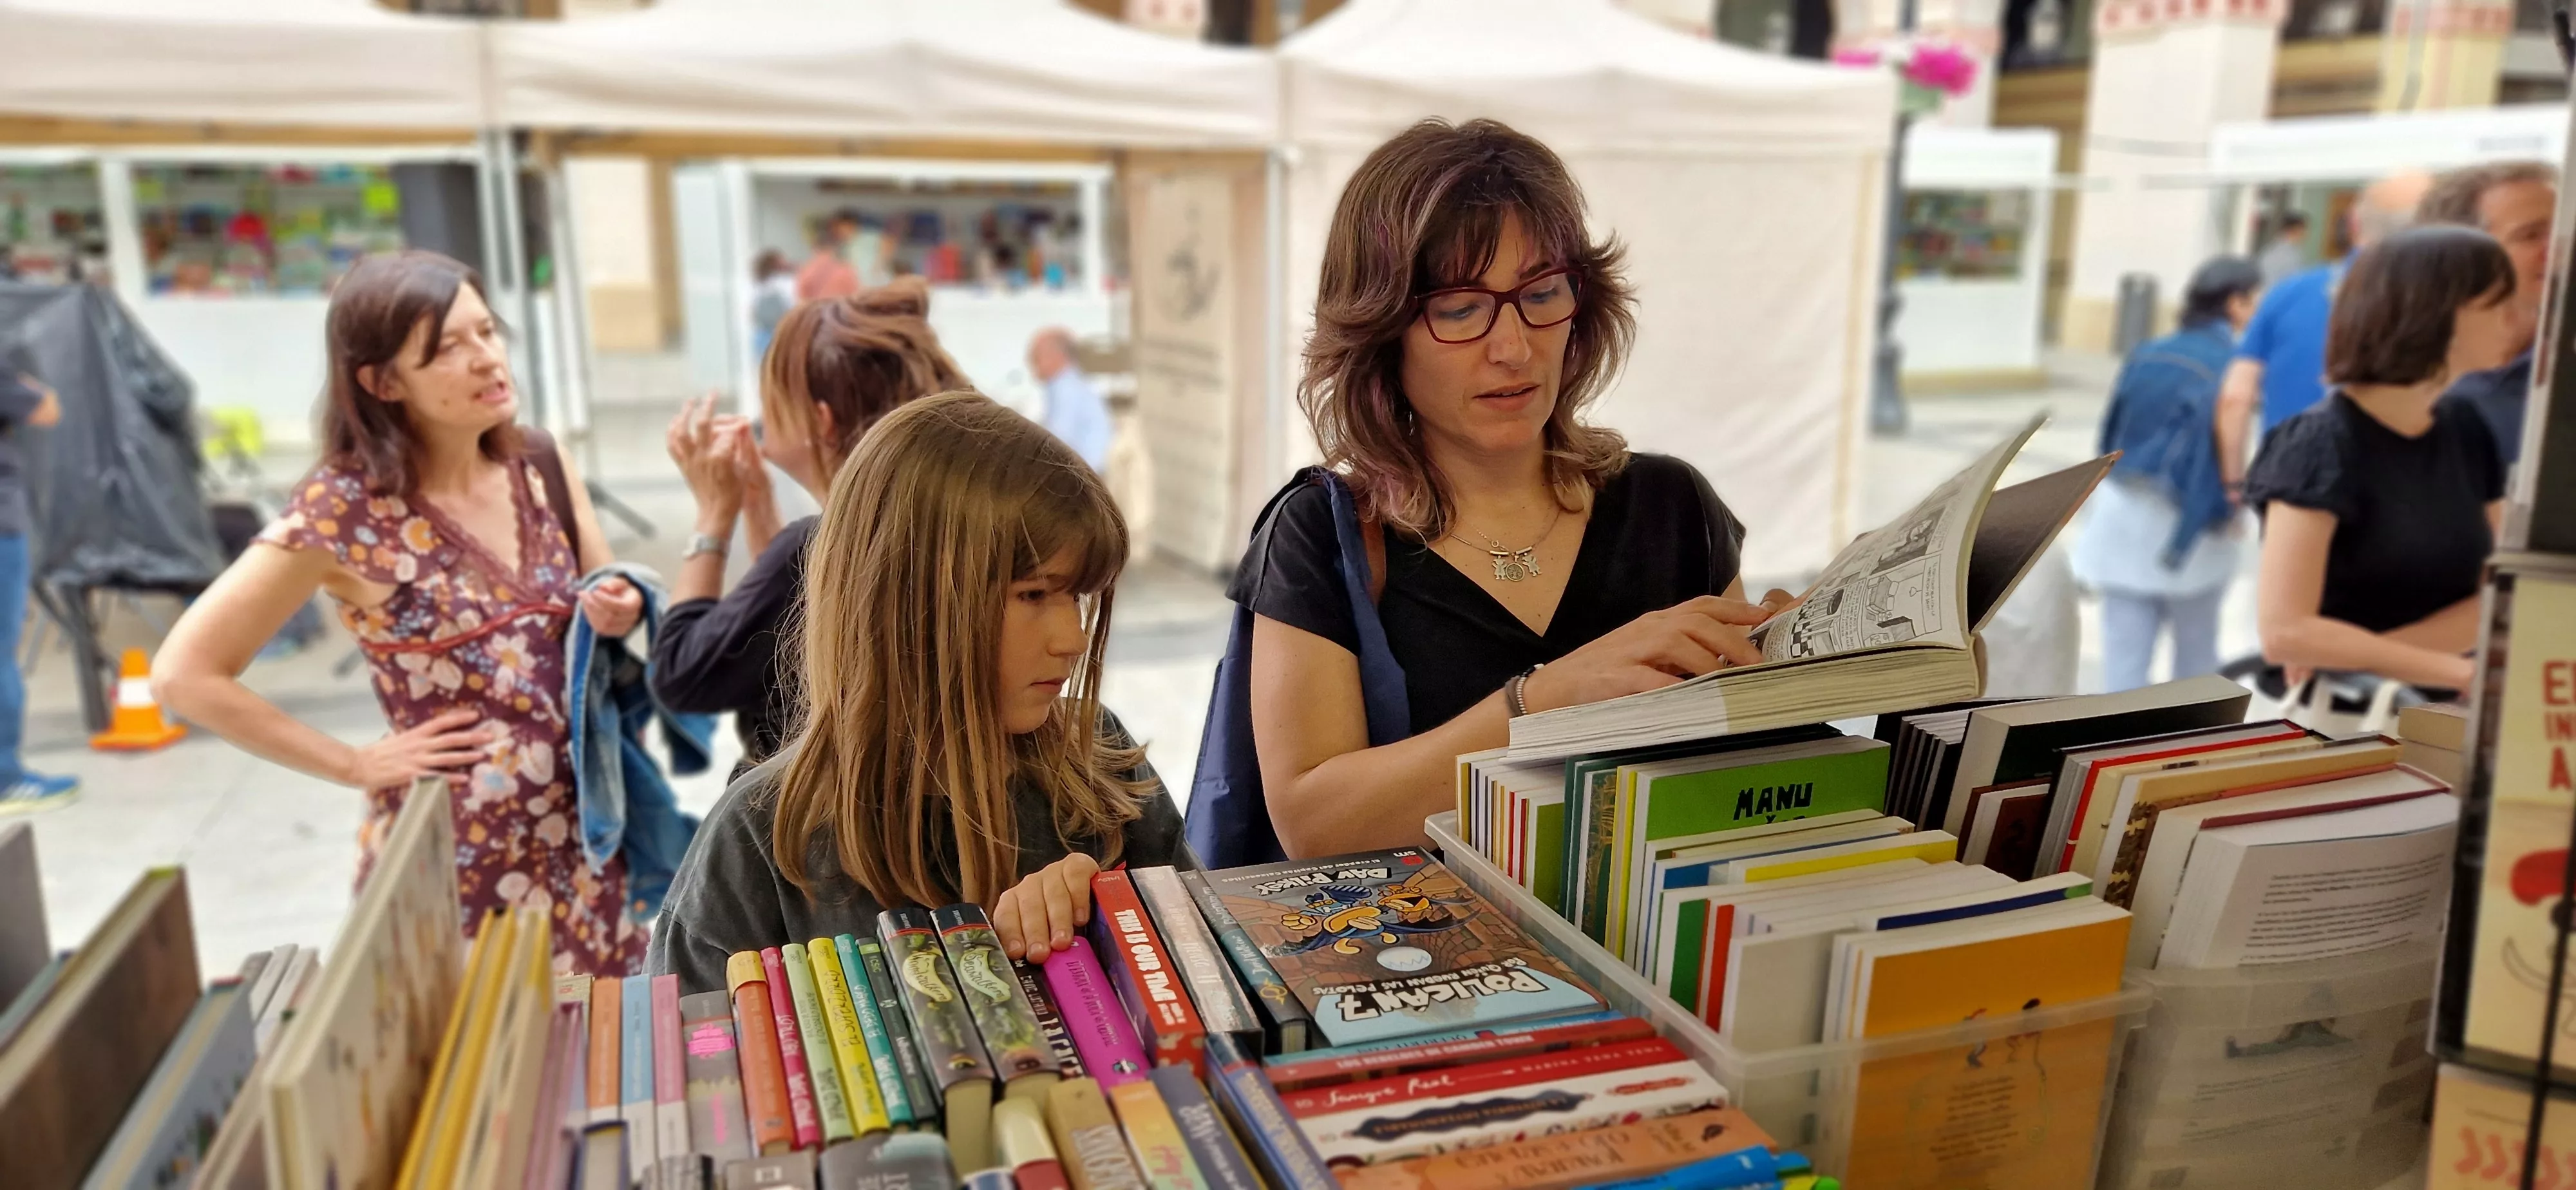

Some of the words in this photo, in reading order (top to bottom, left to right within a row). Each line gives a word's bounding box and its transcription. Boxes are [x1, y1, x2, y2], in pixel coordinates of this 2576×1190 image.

[1733, 782, 1814, 821] MANU
[1337, 867, 1389, 880] DAV
[1114, 909, 1144, 933] THIS
[1124, 932, 1150, 944] IS
[1130, 944, 1162, 972] OUR
[909, 954, 950, 1001] Woodwalkers
[964, 952, 1005, 999] Seawalkers
[1143, 971, 1177, 1003] TIME
[1372, 969, 1547, 1012] POLICÁN
[1380, 979, 1405, 990] LAS
[1337, 994, 1380, 1021] 7
[1322, 1086, 1397, 1108] Sangre
[1407, 1074, 1456, 1096] Real
